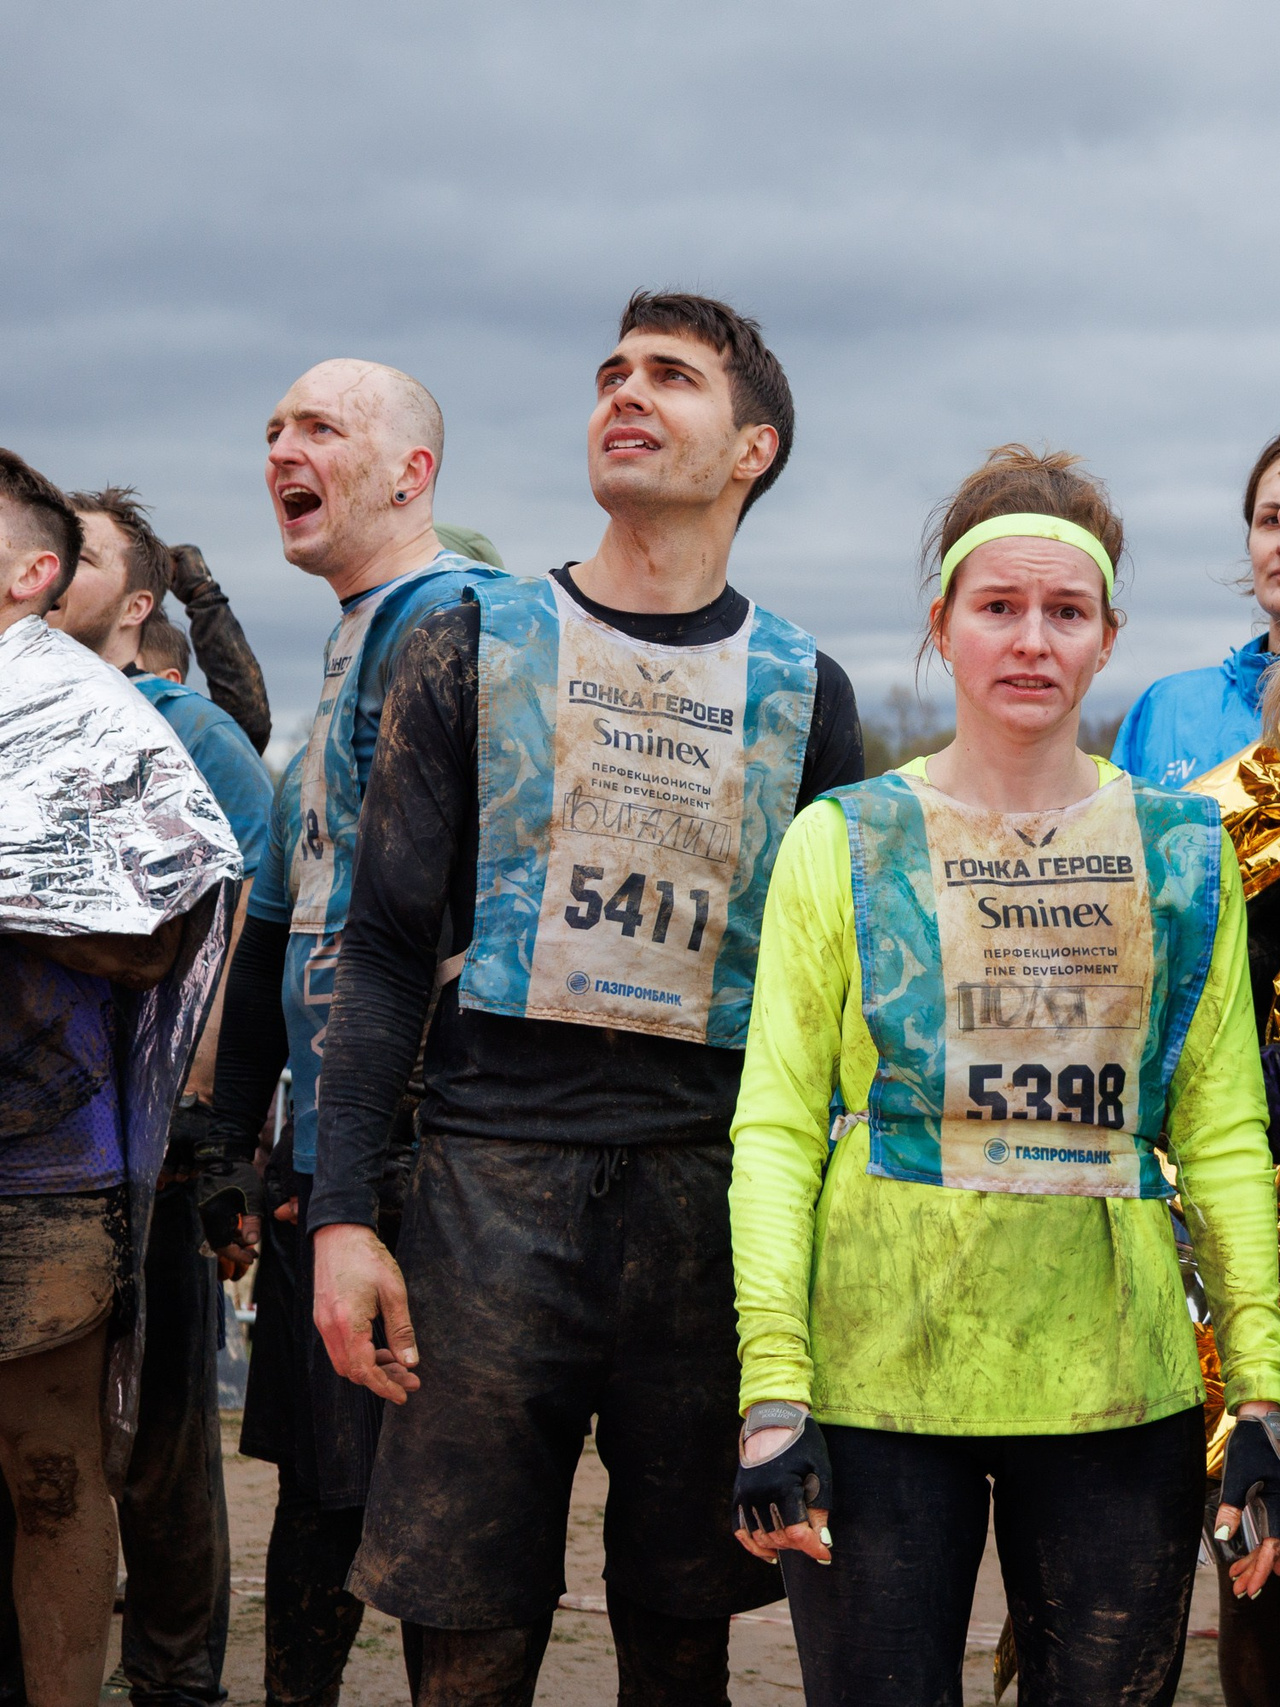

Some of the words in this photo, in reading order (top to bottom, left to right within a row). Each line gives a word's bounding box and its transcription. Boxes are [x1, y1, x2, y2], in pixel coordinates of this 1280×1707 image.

[568, 680, 645, 709] ГОНКА
[652, 692, 734, 727] ГЕРОЕВ
[592, 717, 711, 769] Sminex
[591, 762, 711, 795] ПЕРФЕКЦИОНИСТЫ
[591, 778, 619, 792] FINE
[624, 785, 711, 810] DEVELOPMENT
[944, 858, 1031, 879] ГОНКА
[1038, 855, 1134, 877] ГЕРОЕВ
[563, 864, 710, 952] 5411
[977, 896, 1114, 929] Sminex
[983, 946, 1118, 960] ПЕРФЕКЦИОНИСТЫ
[985, 966, 1016, 977] FINE
[1022, 964, 1119, 976] DEVELOPMENT
[594, 979, 682, 1007] ГАЗПРОМБАНК
[966, 1063, 1126, 1130] 5398
[1015, 1145, 1112, 1165] ГАЗПРОМБАНК
